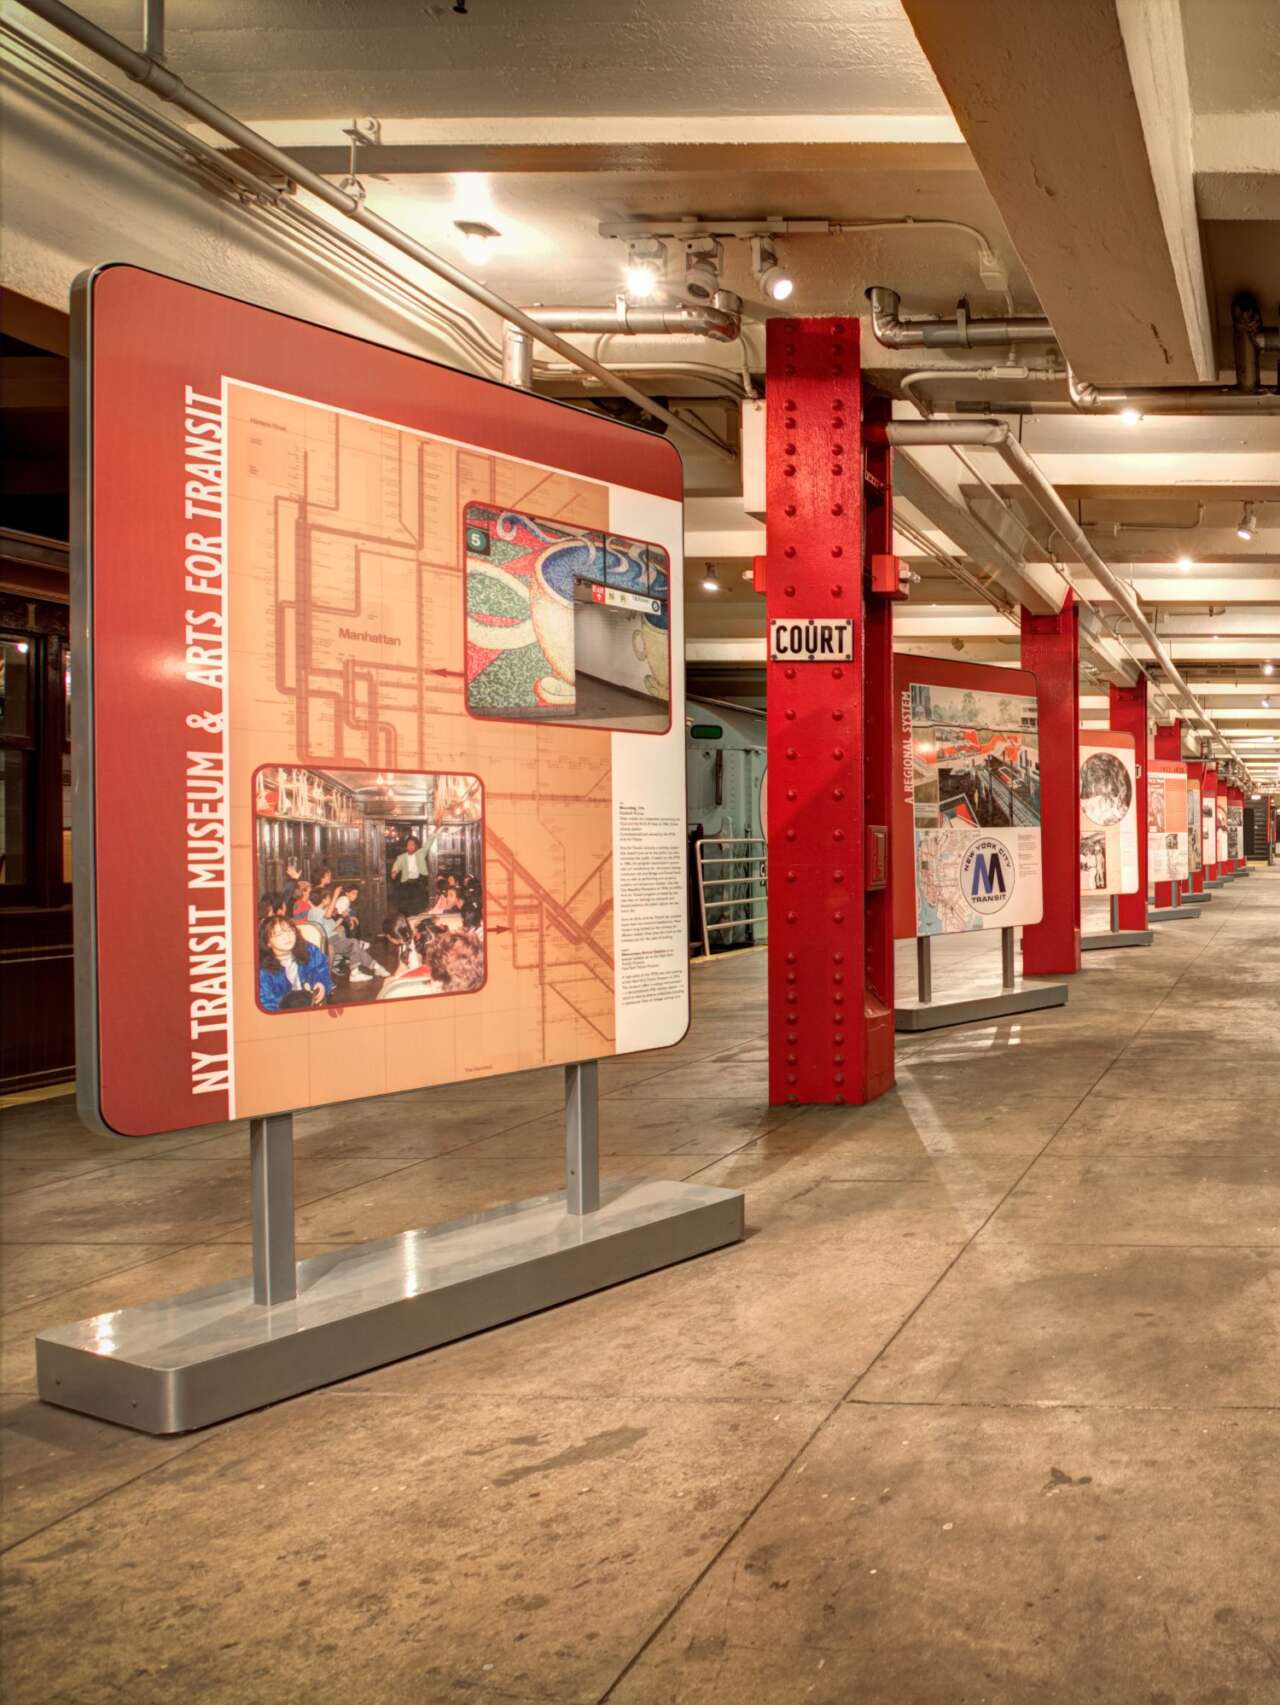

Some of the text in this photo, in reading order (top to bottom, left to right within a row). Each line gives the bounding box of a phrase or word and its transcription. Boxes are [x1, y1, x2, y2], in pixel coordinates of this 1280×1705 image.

[471, 533, 480, 546] 5
[338, 627, 402, 647] Manhattan
[776, 625, 847, 654] COURT
[184, 384, 229, 1095] NY TRANSIT MUSEUM & ARTS FOR TRANSIT
[901, 691, 914, 804] A REGIONAL SYSTEM
[963, 850, 975, 871] NEW
[975, 842, 996, 850] YORK
[998, 848, 1012, 867] CITY
[971, 894, 1006, 903] TRANSIT
